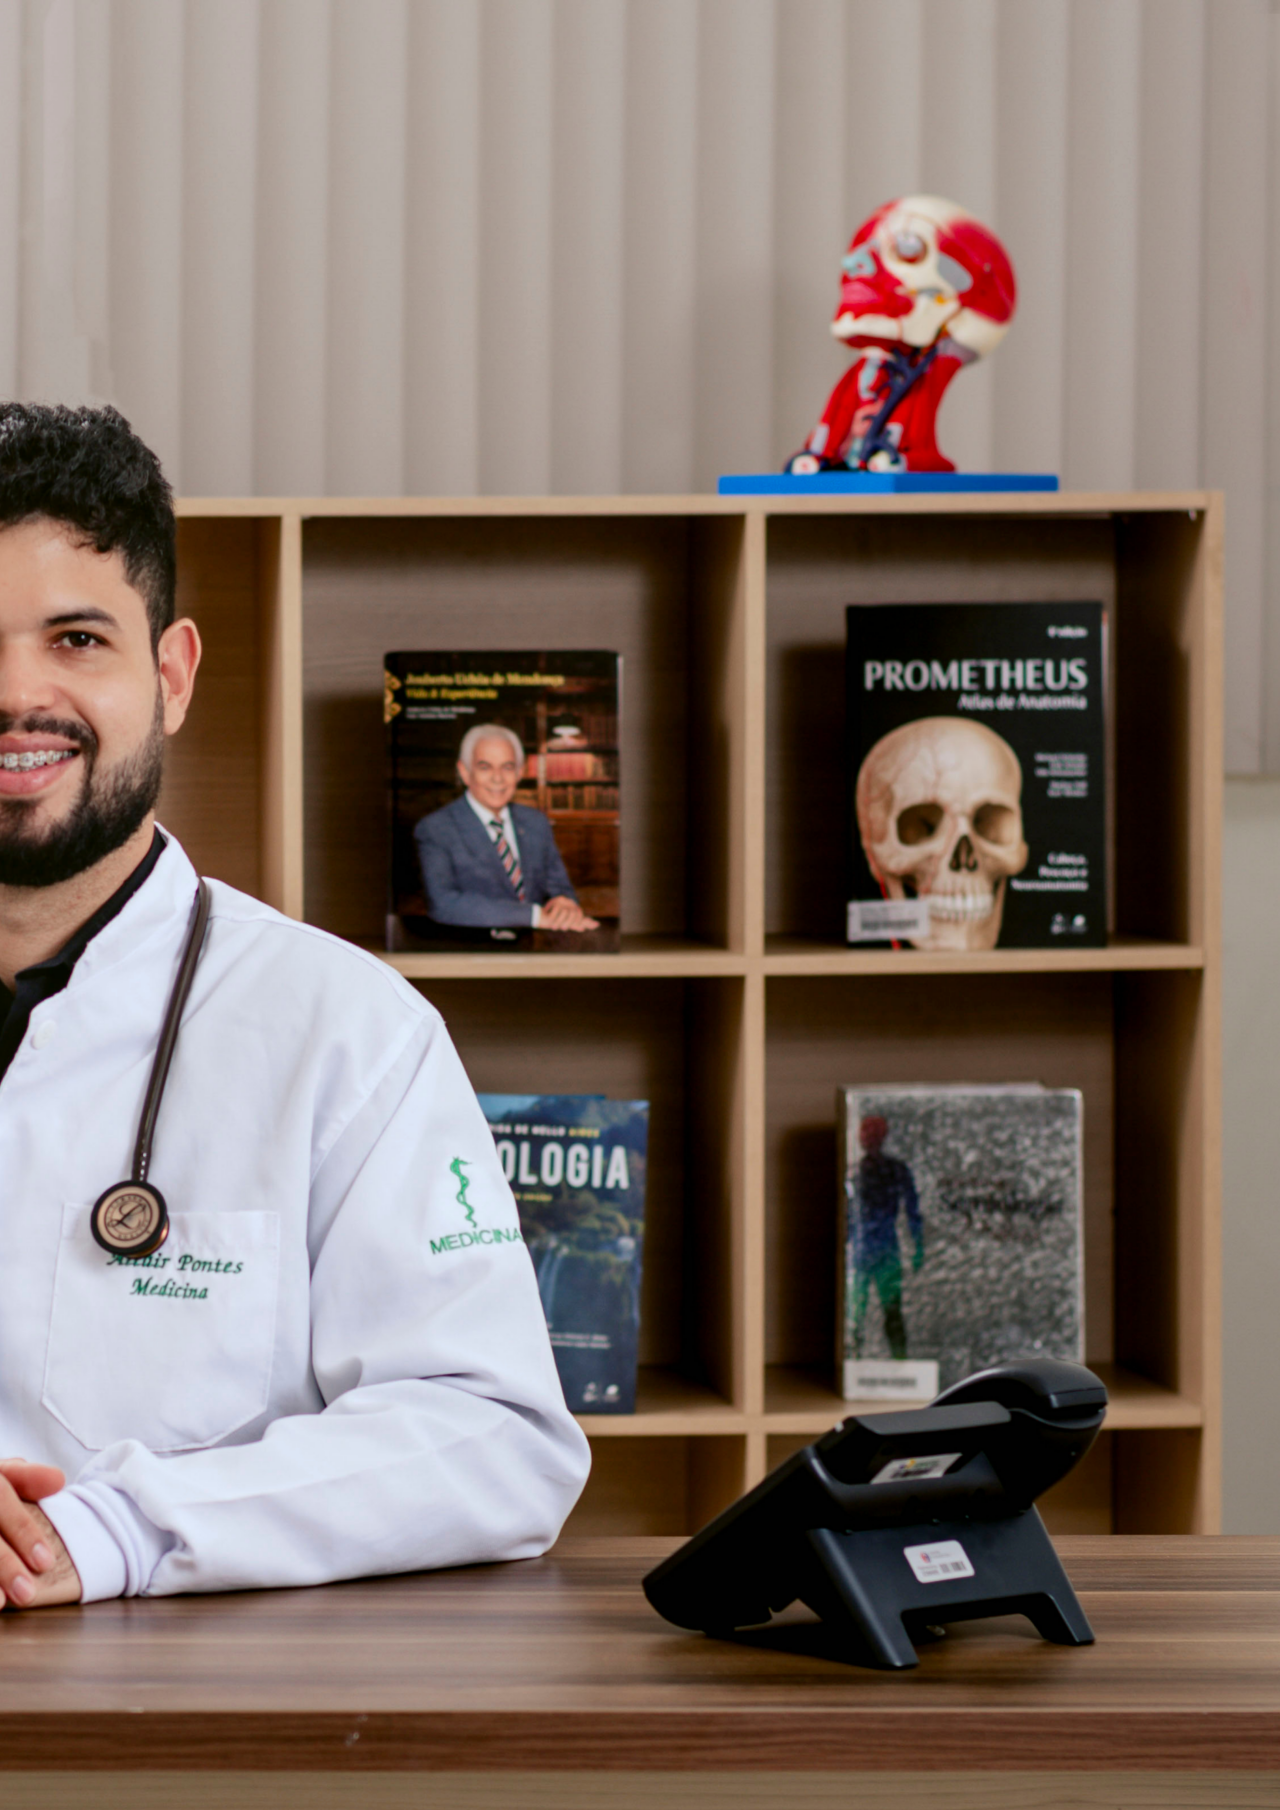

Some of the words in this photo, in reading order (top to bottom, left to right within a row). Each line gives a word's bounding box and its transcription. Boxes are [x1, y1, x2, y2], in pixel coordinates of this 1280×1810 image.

[864, 659, 1088, 691] PROMETHEUS
[957, 693, 995, 710] Atlas
[996, 693, 1015, 710] de
[1017, 693, 1087, 710] Anatomia
[430, 1227, 523, 1255] MEDICINA
[177, 1254, 243, 1274] Pontes
[130, 1276, 209, 1300] Medicina
